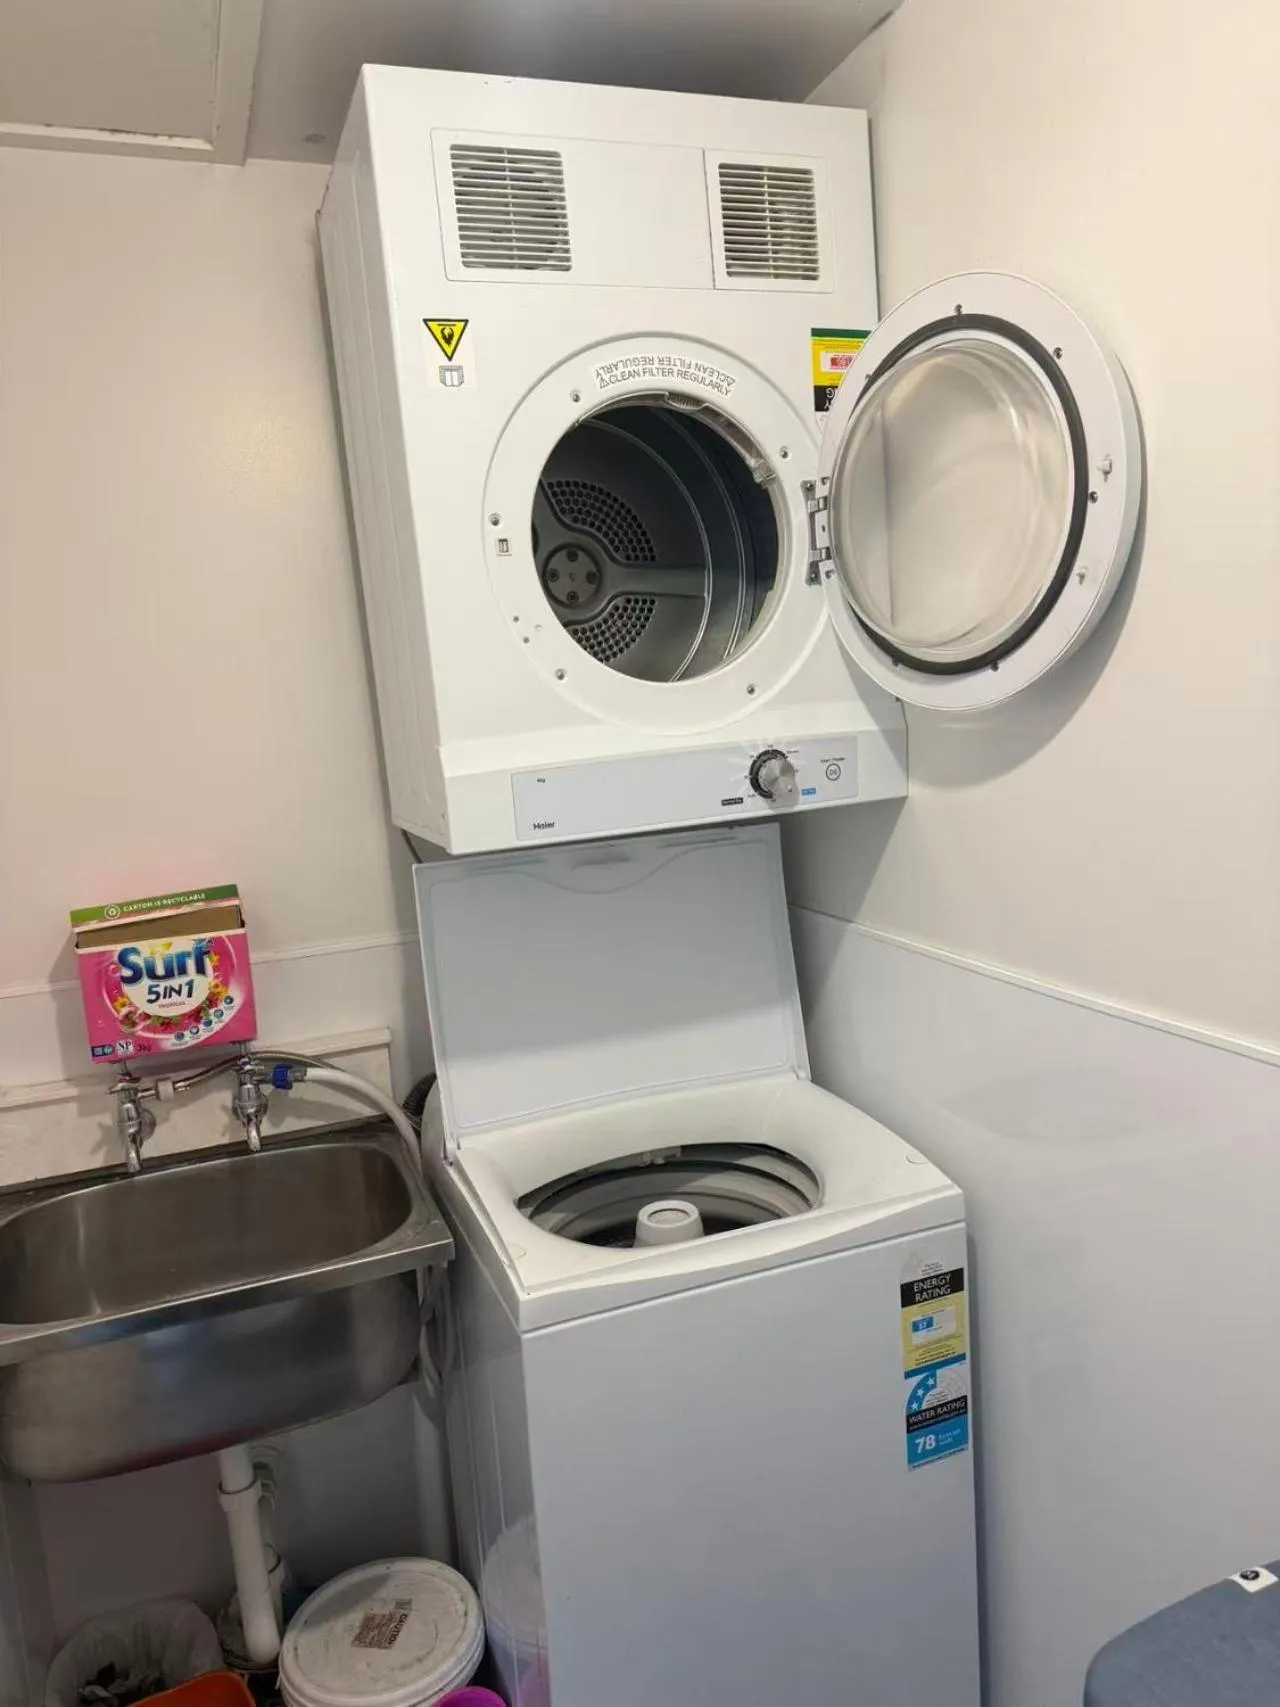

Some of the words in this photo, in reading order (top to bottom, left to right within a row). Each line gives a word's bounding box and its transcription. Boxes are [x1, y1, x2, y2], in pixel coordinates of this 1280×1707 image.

[595, 355, 655, 378] REGULARLY
[657, 356, 692, 369] FILTER
[609, 368, 641, 385] CLEAN
[642, 367, 675, 378] FILTER
[676, 370, 732, 397] REGULARLY
[694, 363, 730, 384] CLEAN
[533, 821, 555, 830] Haier
[123, 901, 153, 912] CARTON
[161, 892, 206, 906] RECYCLABLE
[118, 937, 213, 985] Surf
[913, 1274, 952, 1292] ENERGY
[915, 1285, 951, 1303] RATING
[909, 1410, 937, 1424] WATER
[937, 1401, 967, 1415] RATING
[915, 1434, 937, 1454] 78
